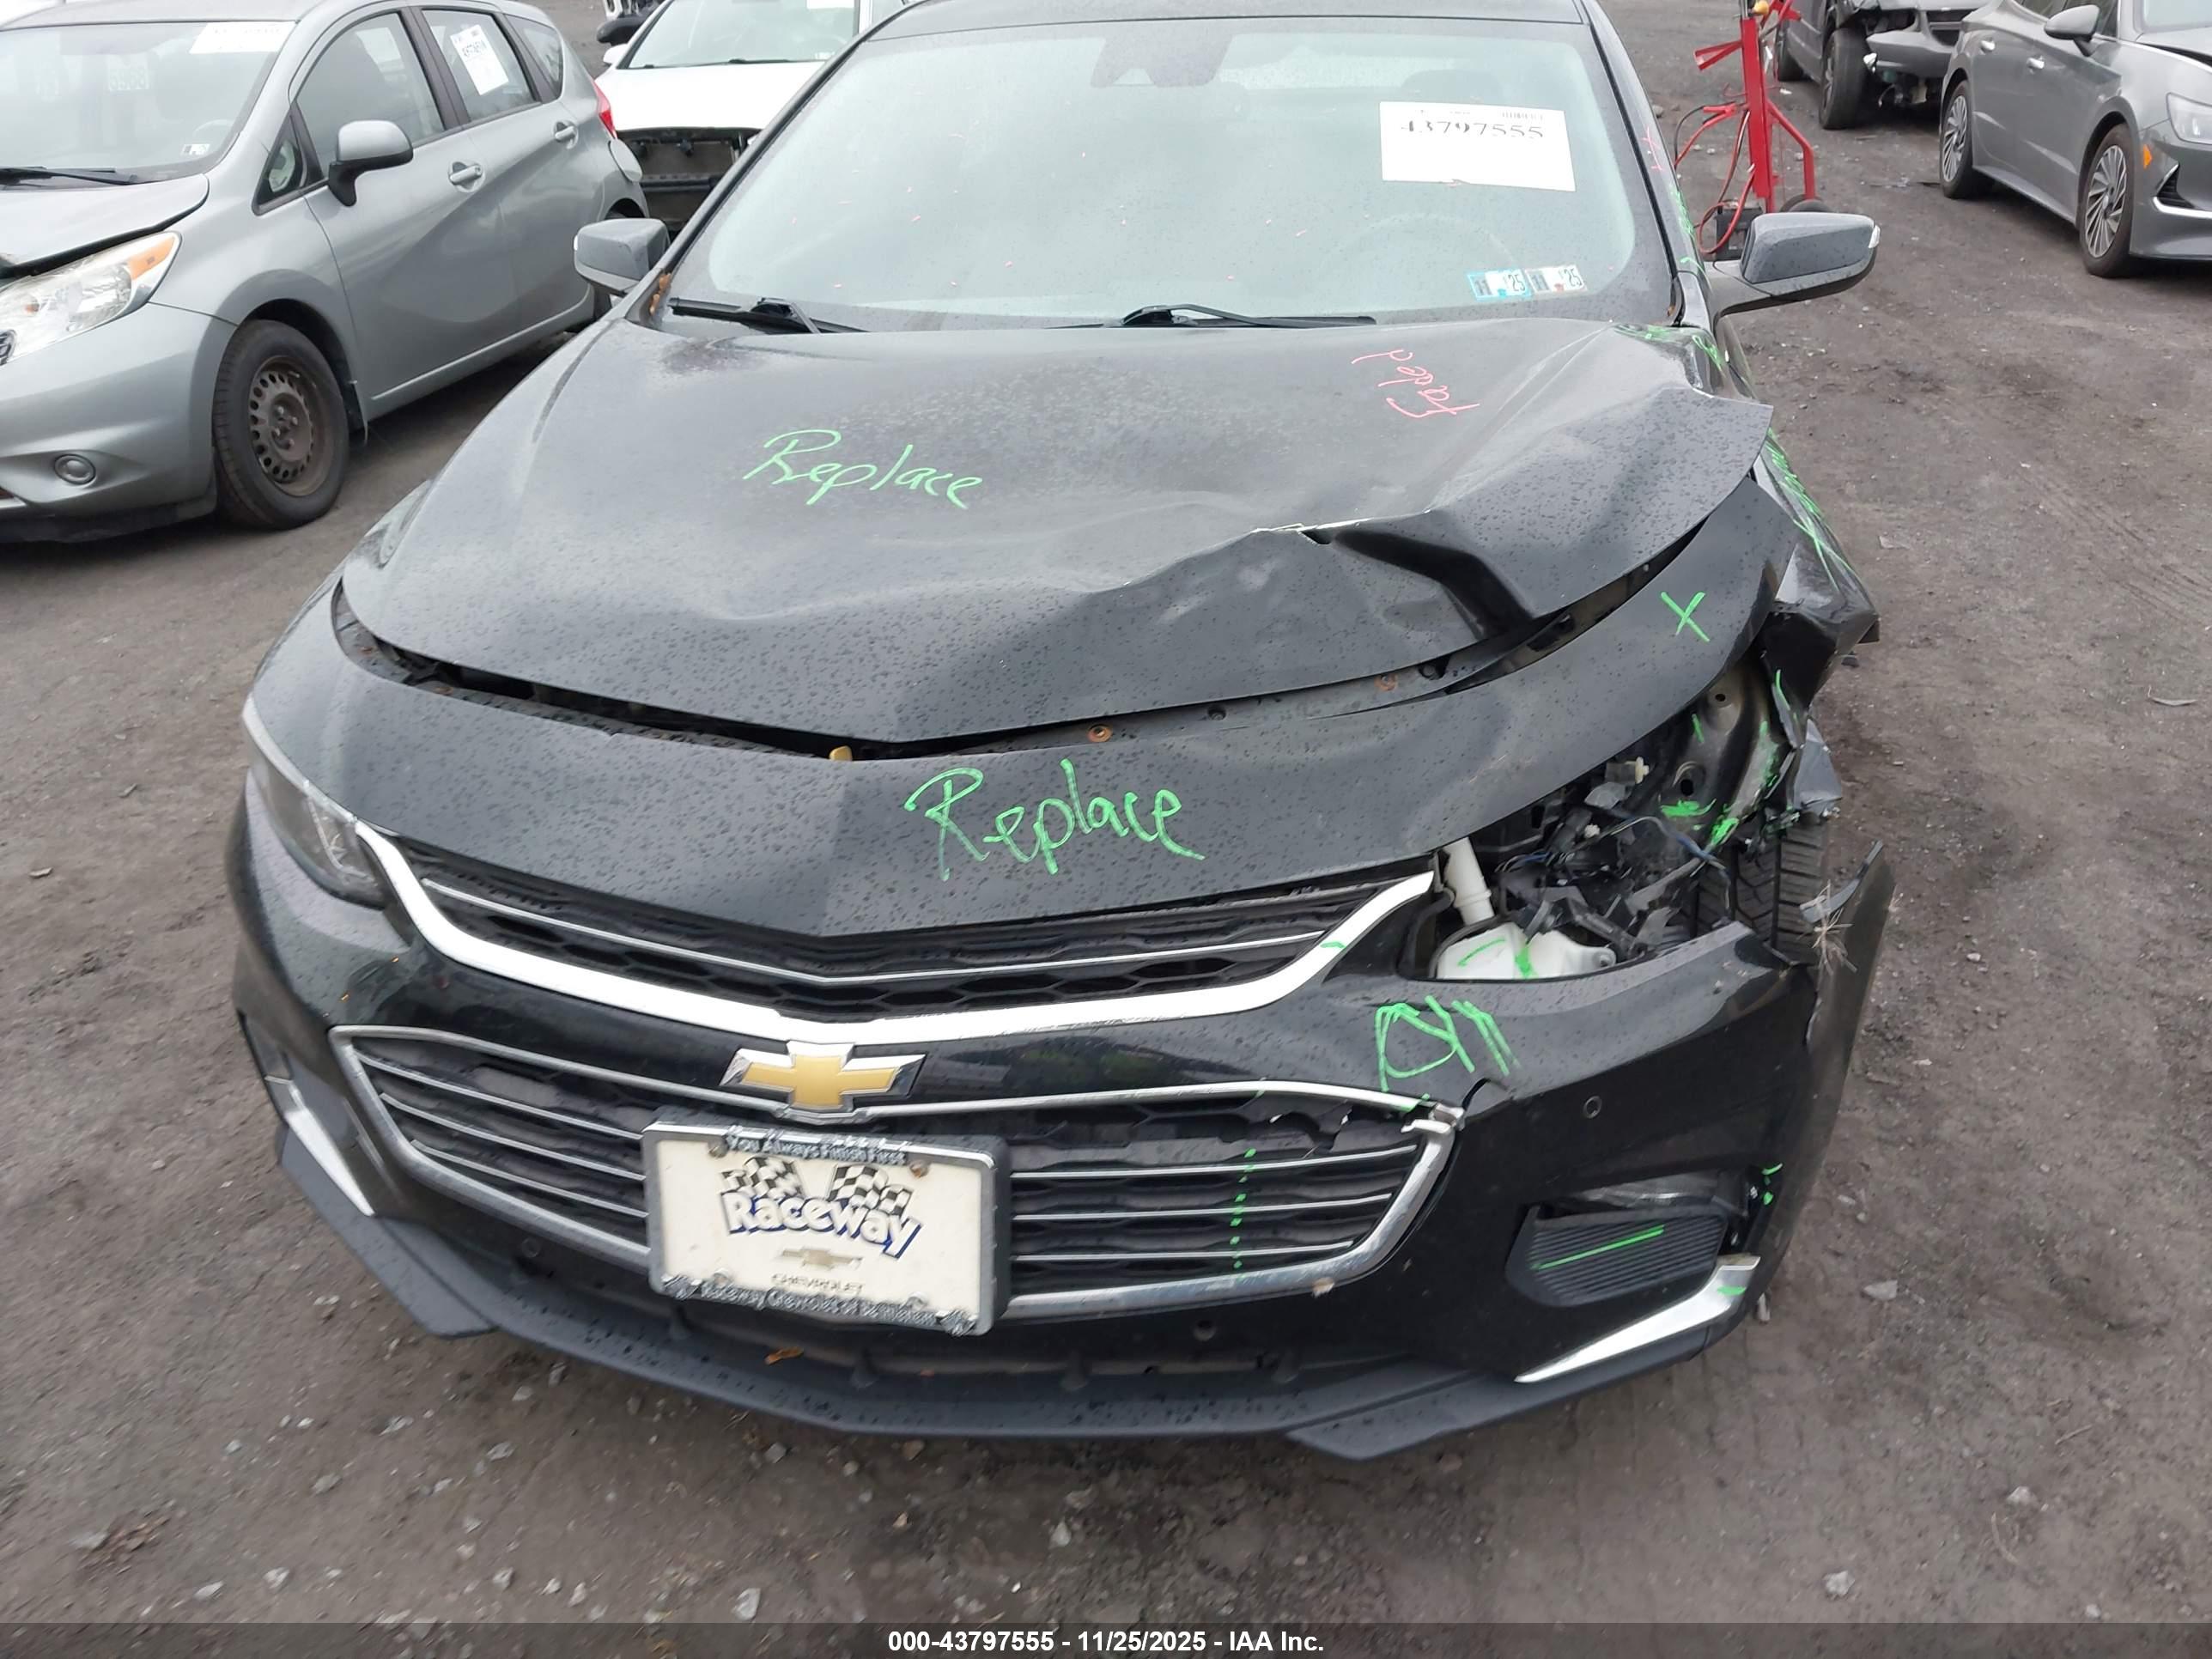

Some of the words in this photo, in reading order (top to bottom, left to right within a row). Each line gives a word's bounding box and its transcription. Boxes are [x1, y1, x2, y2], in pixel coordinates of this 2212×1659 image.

[744, 428, 982, 509] Replace
[904, 759, 1205, 880] Replace
[720, 1192, 922, 1260] Raceway
